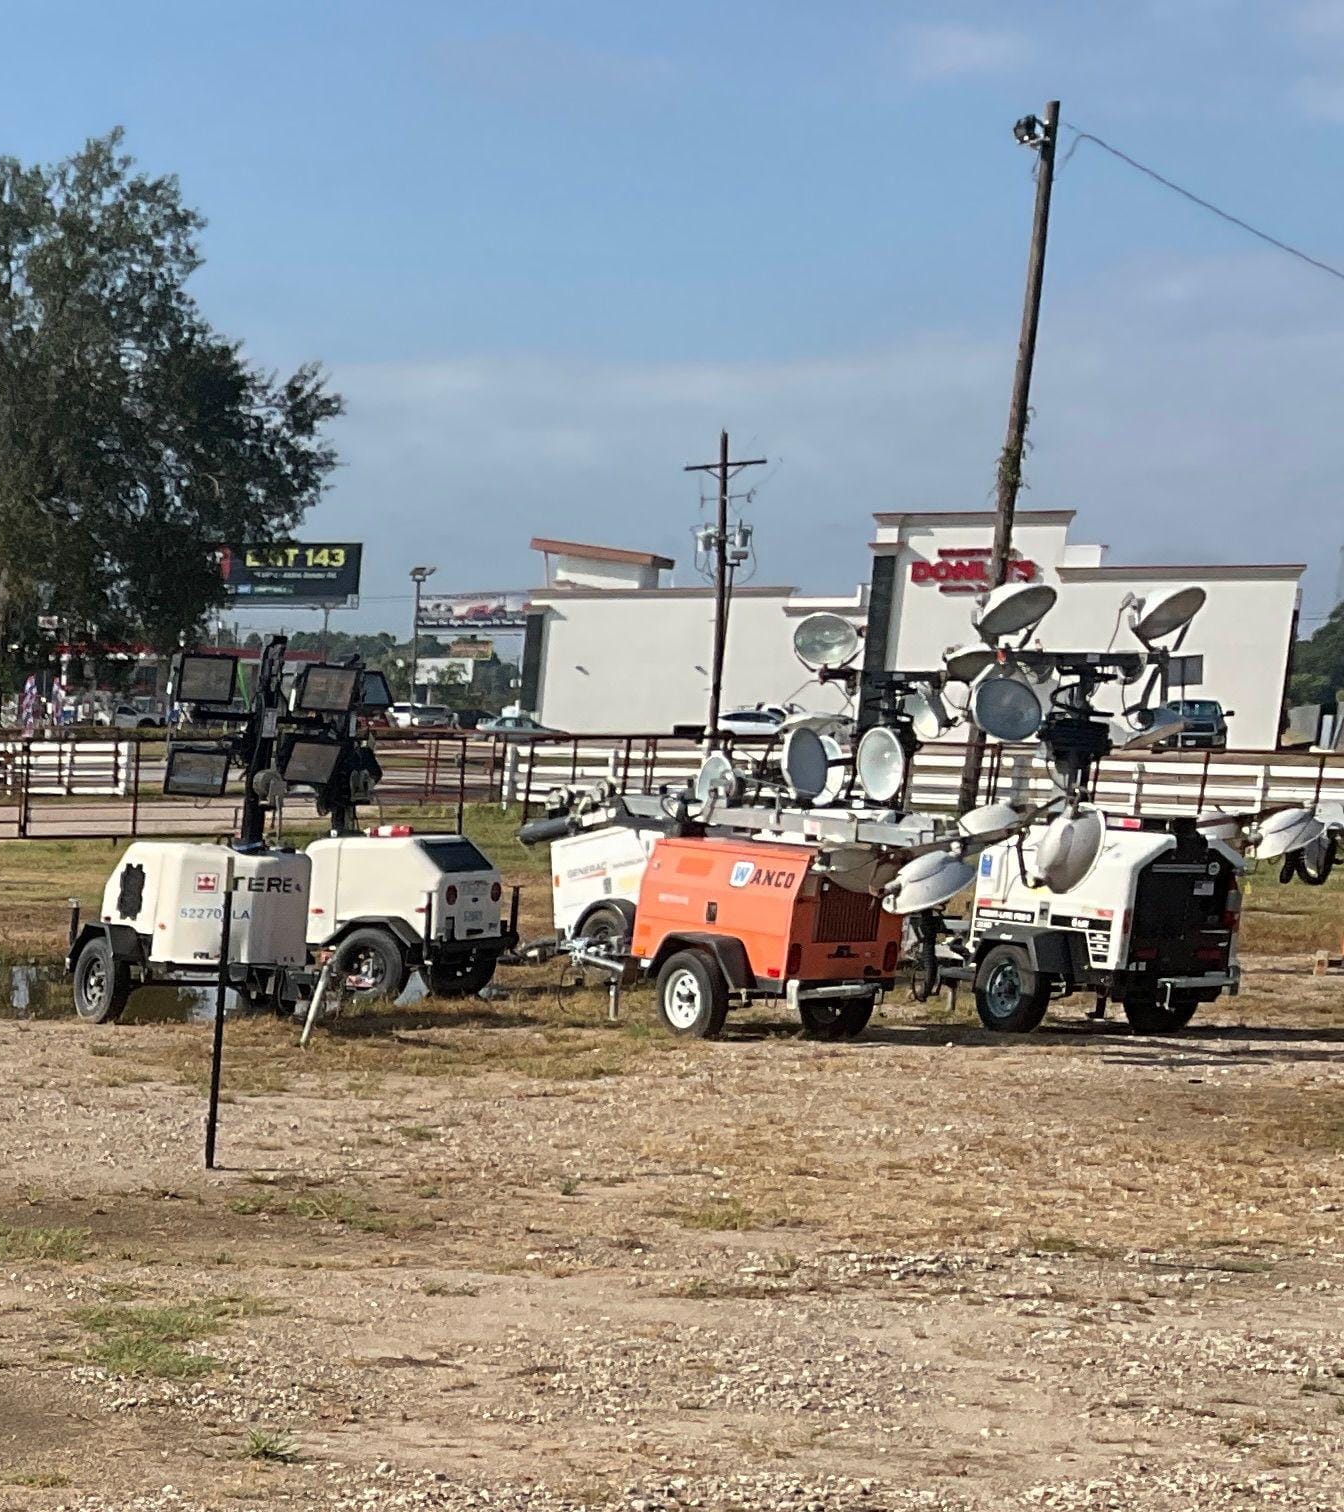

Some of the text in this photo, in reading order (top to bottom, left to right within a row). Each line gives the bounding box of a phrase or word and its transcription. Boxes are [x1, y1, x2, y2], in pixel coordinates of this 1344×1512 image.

[305, 547, 346, 567] 143
[232, 876, 302, 893] TERE
[733, 865, 795, 889] WANCO
[232, 909, 251, 920] LA
